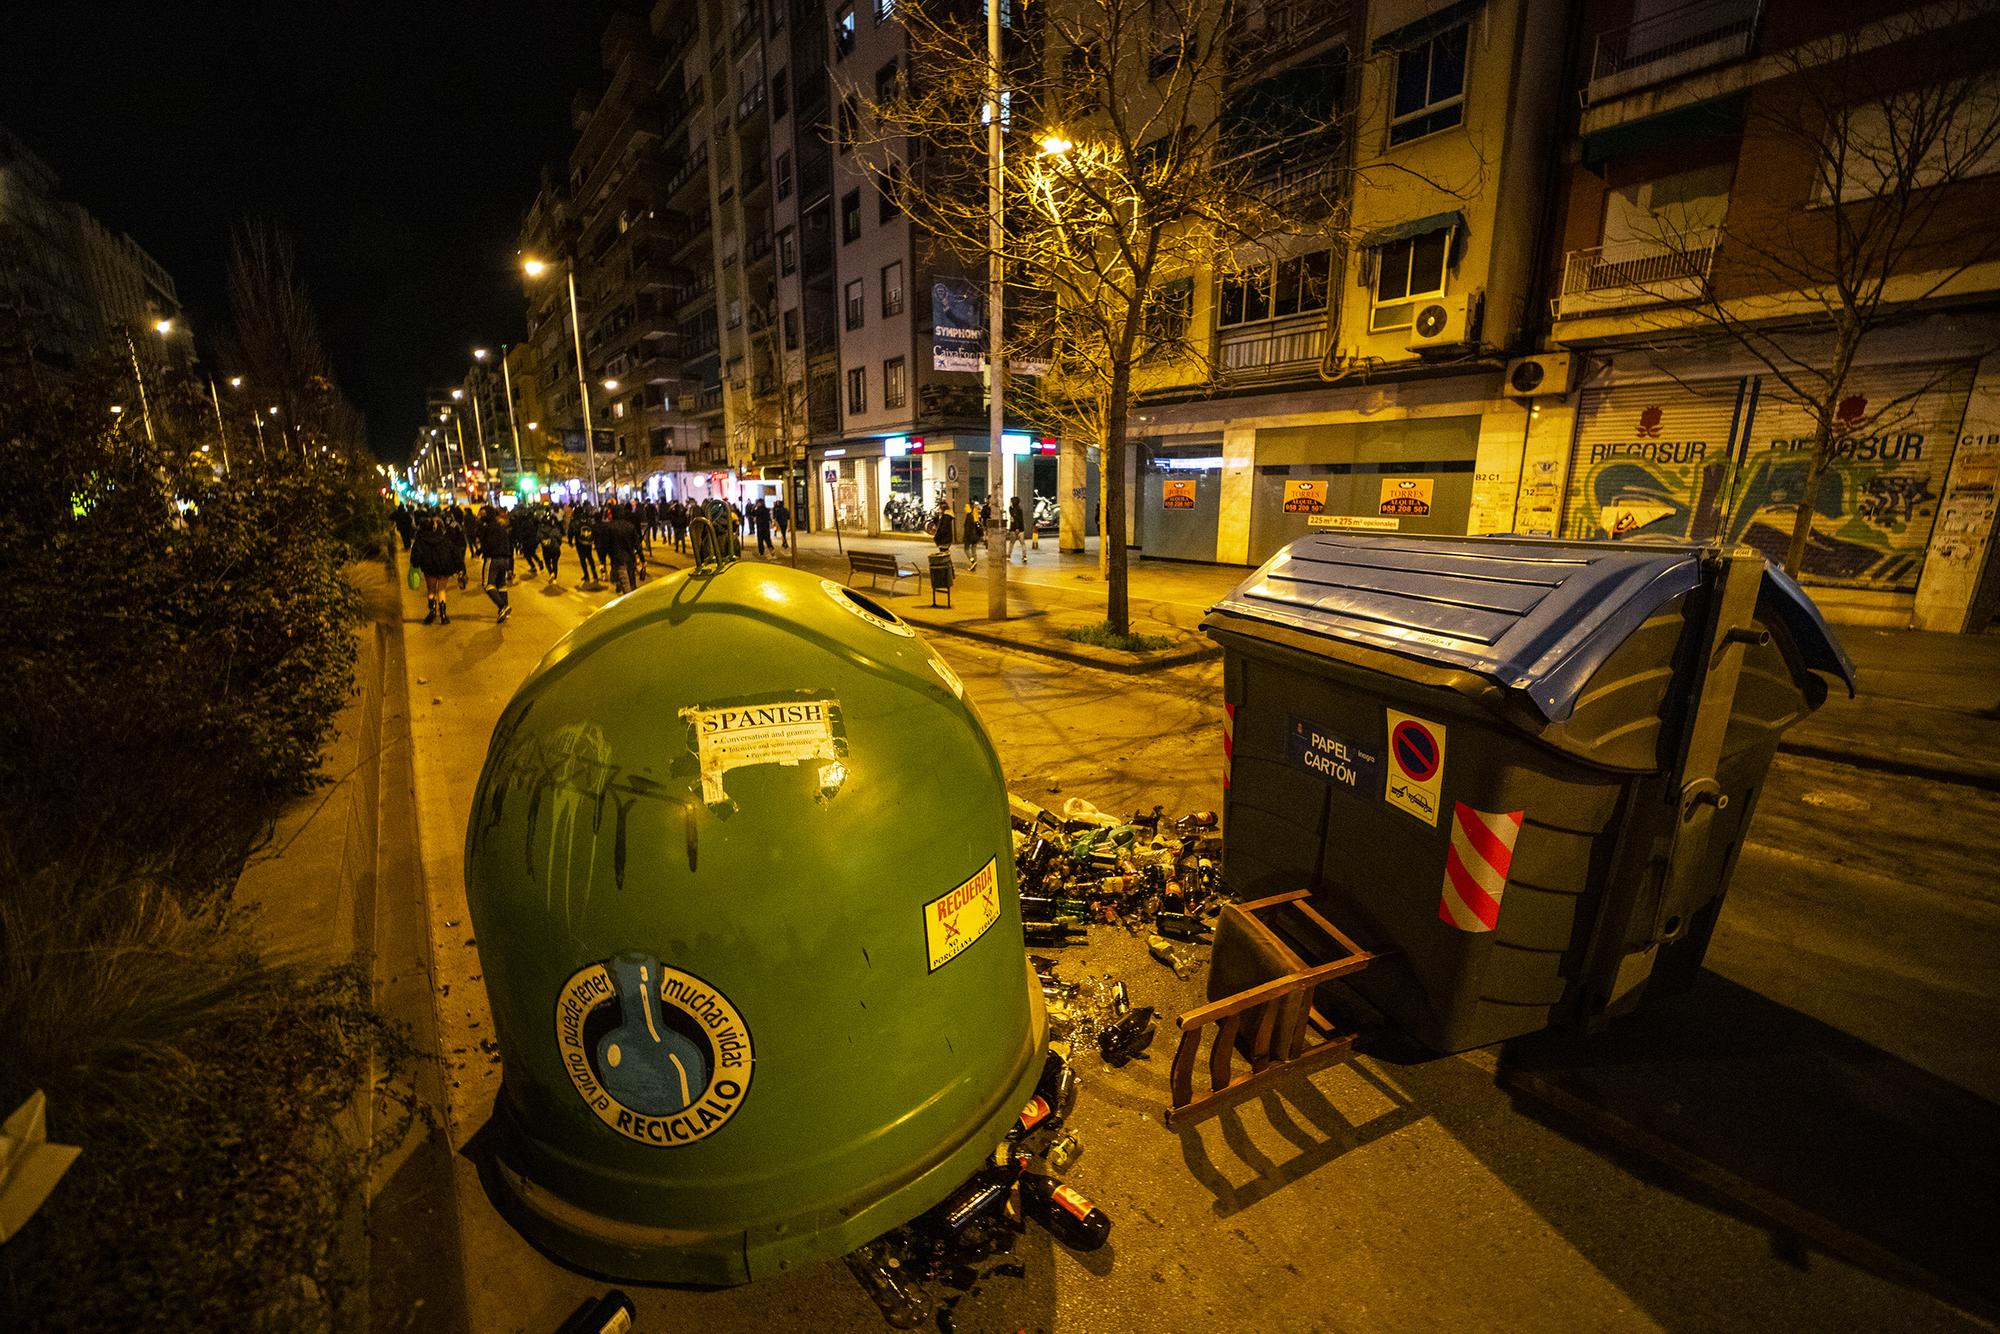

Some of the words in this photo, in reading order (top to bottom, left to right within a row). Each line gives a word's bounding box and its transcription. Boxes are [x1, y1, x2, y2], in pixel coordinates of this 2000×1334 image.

[1590, 441, 1706, 464] RIEGOSUR
[1291, 490, 1320, 498] TORRES
[1389, 490, 1424, 498] TORRES
[1310, 516, 1323, 524] 225
[1339, 517, 1352, 525] 275
[1363, 519, 1397, 528] opcionales
[1397, 505, 1411, 513] 208
[703, 705, 822, 733] SPANISH
[720, 733, 770, 745] Conversation
[771, 730, 785, 738] and
[758, 741, 770, 749] and
[1311, 732, 1352, 763] PAPEL
[1304, 751, 1356, 786] CARTÓN
[937, 866, 992, 922] RECUERDA
[572, 973, 610, 1006] tener
[663, 978, 728, 1030] muchas
[563, 996, 583, 1048] puede
[716, 1027, 746, 1068] vidas
[567, 1053, 598, 1096] vidrio
[591, 1097, 610, 1110] el
[617, 1079, 741, 1142] RECICLALO
